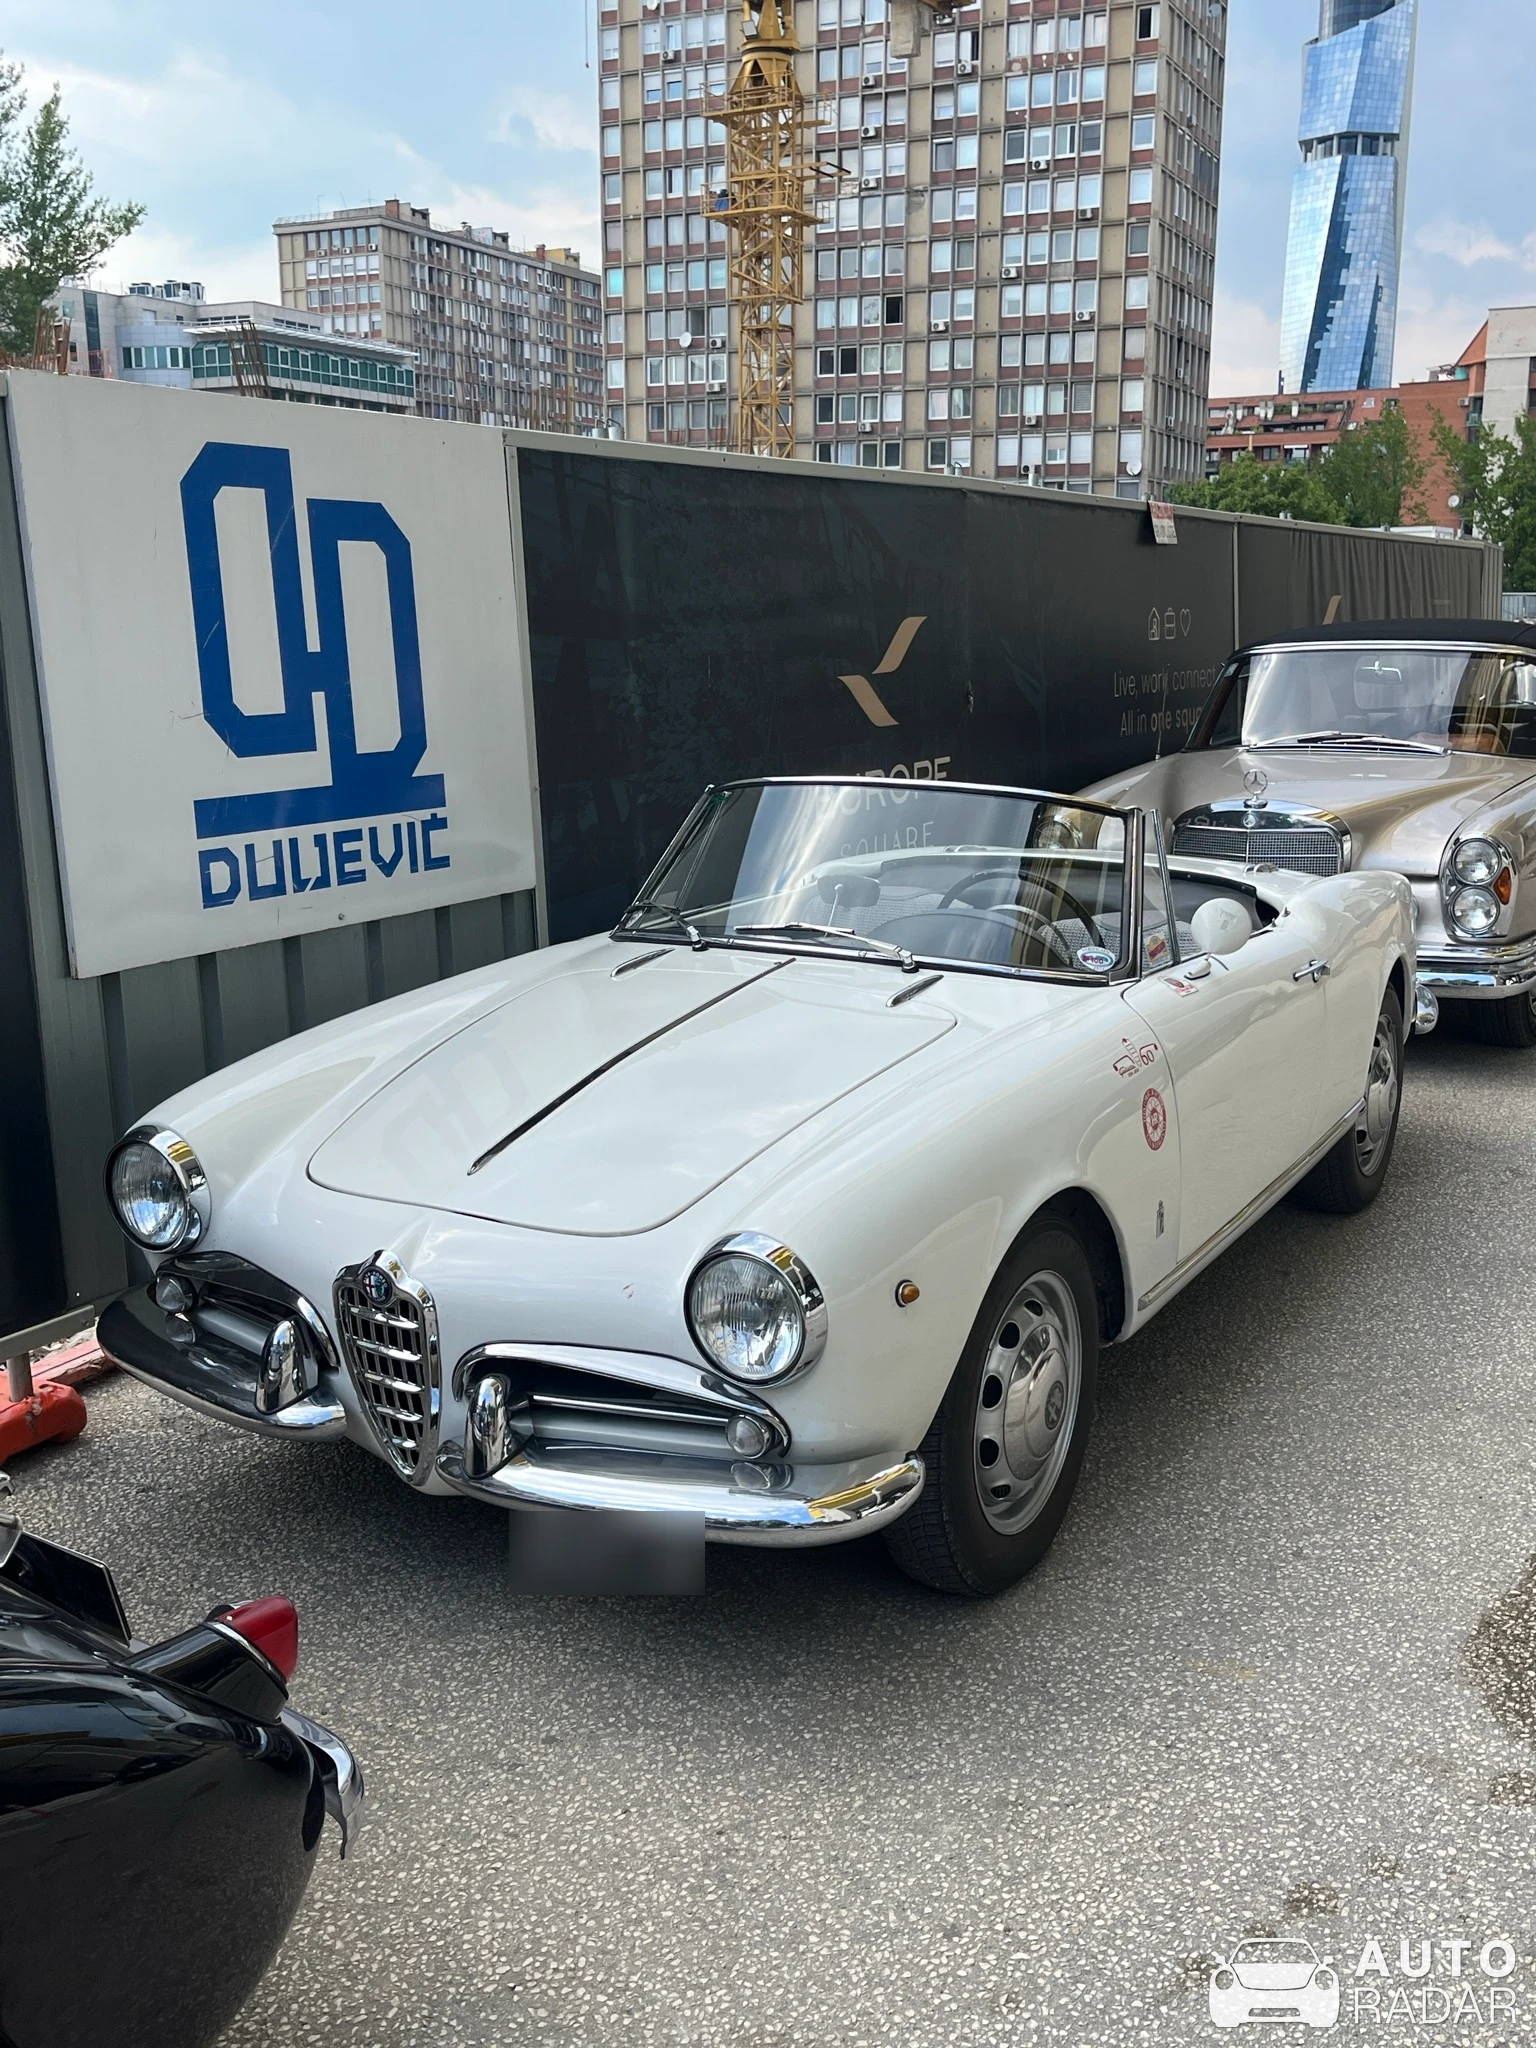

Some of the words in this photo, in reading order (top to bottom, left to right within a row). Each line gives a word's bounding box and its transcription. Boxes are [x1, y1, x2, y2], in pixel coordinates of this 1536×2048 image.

[1113, 671, 1139, 699] Live,
[1120, 709, 1134, 737] All
[1136, 709, 1147, 734] in
[1150, 711, 1172, 732] one
